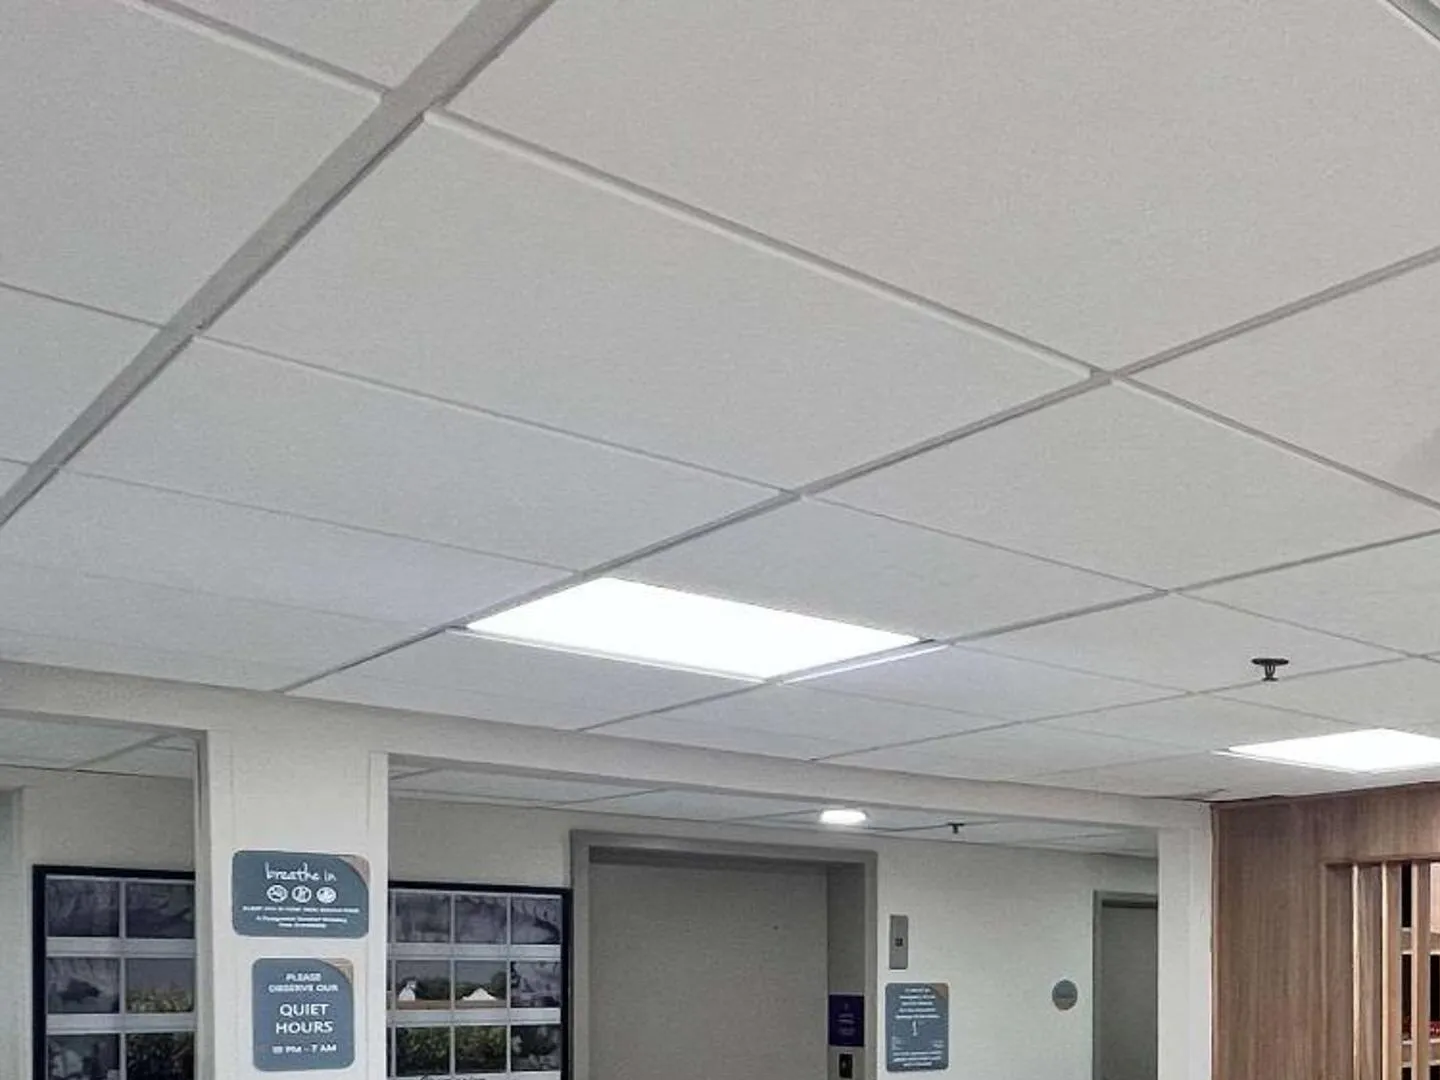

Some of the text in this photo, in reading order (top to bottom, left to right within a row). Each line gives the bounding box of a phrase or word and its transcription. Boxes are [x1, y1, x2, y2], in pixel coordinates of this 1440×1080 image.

[265, 861, 337, 882] breathe in
[285, 973, 321, 982] PLEASE
[268, 984, 339, 992] OBSERVE OUR
[280, 1003, 329, 1017] QUIET
[276, 1021, 334, 1034] HOURS
[312, 1044, 318, 1053] 7
[320, 1044, 337, 1052] AM
